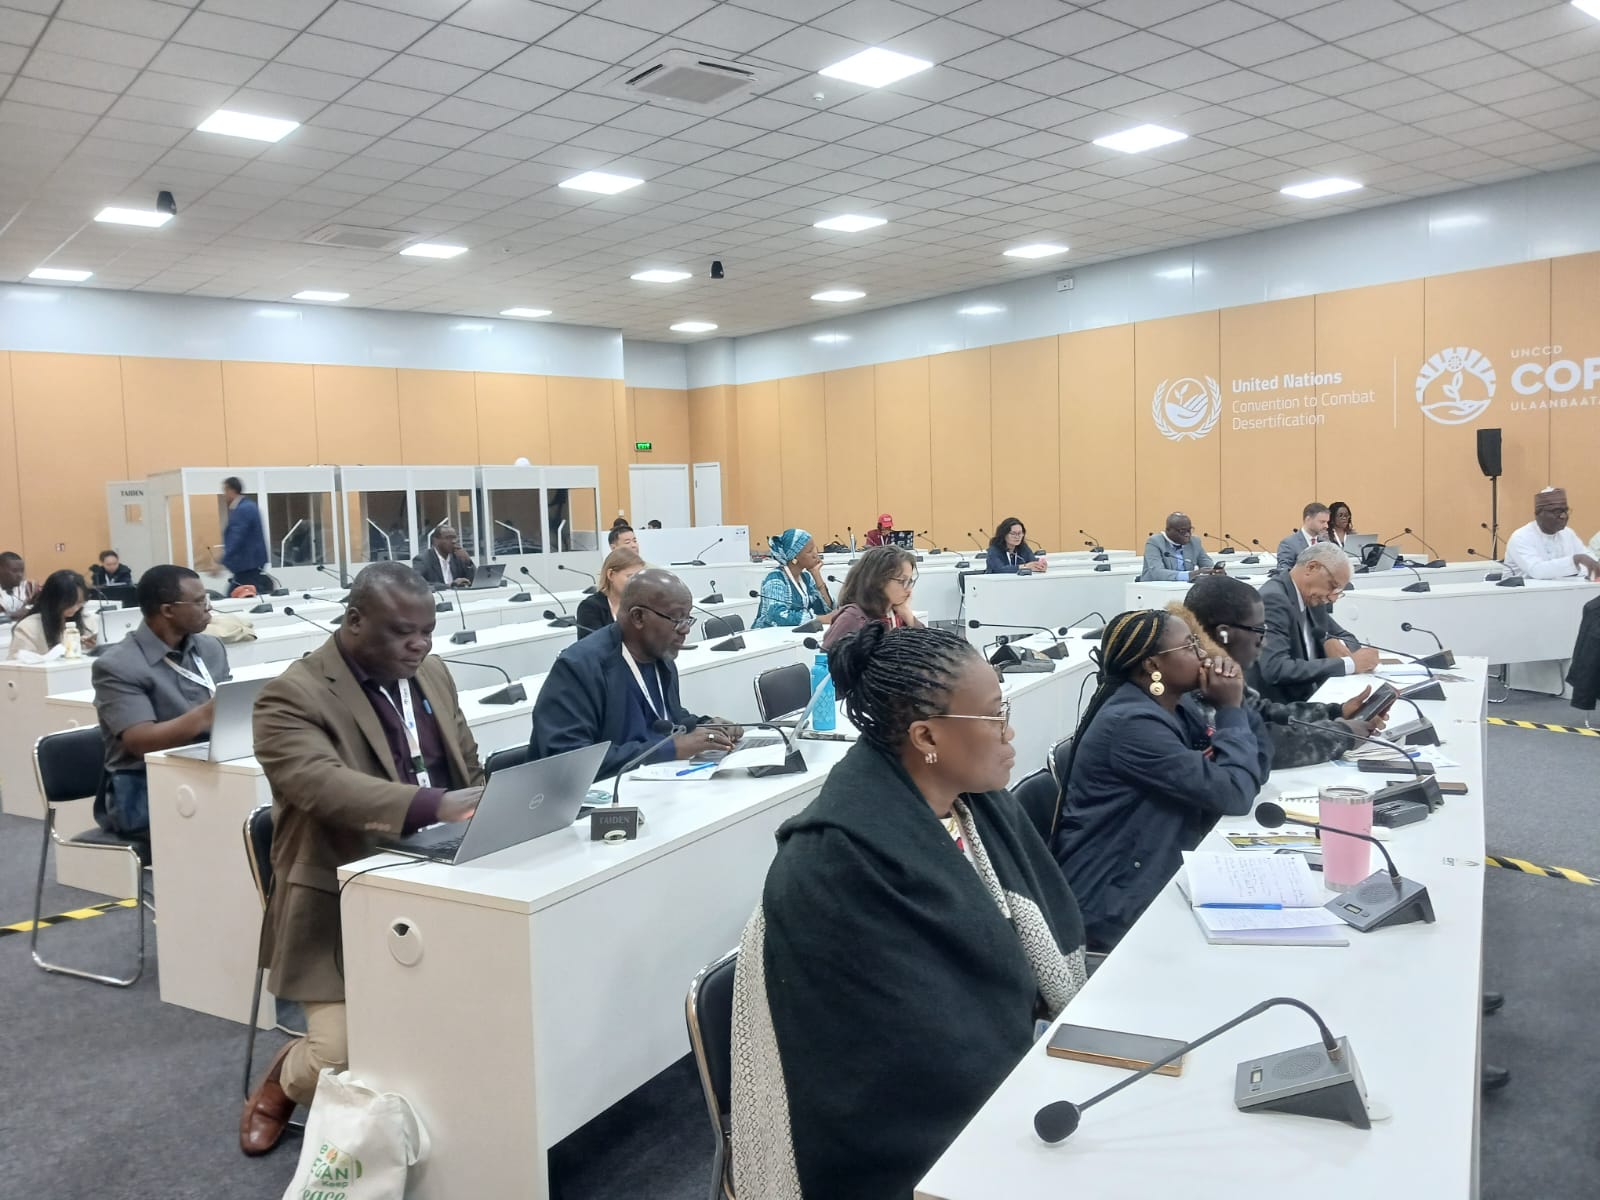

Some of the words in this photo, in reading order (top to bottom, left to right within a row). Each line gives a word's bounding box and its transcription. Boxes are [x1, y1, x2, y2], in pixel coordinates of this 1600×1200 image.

[1511, 345, 1563, 359] UNCCD
[1232, 376, 1278, 393] United
[1283, 371, 1343, 389] Nations
[1232, 397, 1300, 414] Convention
[1304, 395, 1318, 408] to
[1321, 389, 1376, 407] Combat
[1511, 396, 1600, 412] ULAANBAAT
[1232, 413, 1325, 431] Desertification
[600, 815, 630, 825] TAIDEN
[303, 1190, 346, 1200] eace
